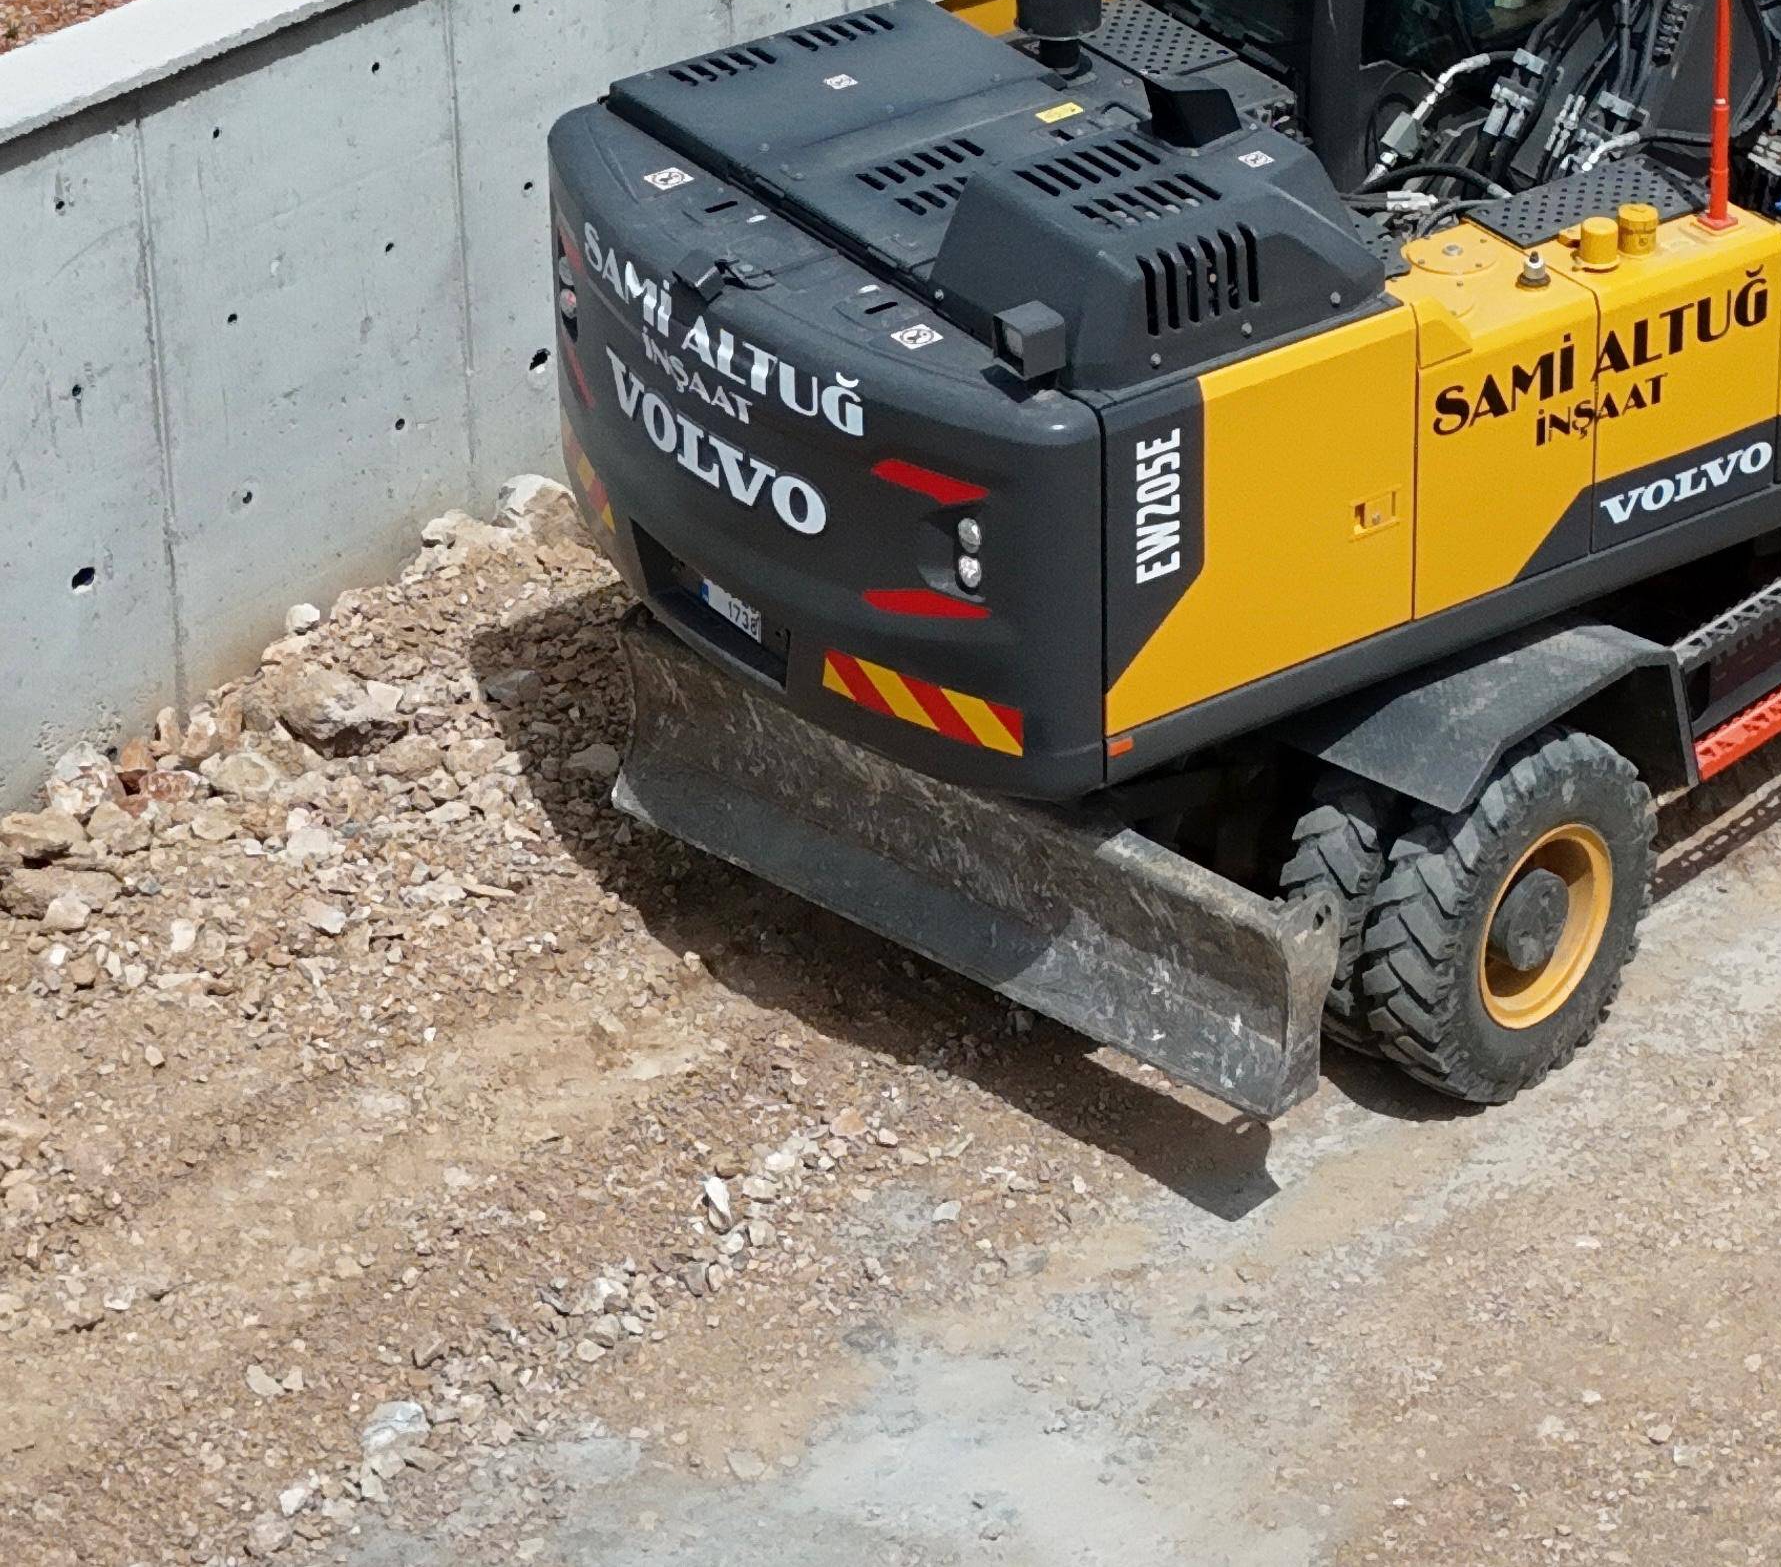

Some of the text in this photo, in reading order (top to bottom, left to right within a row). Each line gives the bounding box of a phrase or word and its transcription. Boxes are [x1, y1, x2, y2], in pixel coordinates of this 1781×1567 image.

[584, 221, 864, 437] SAMİ ALTUĞ
[641, 326, 753, 425] İNŞAAT
[1432, 265, 1769, 436] SAMİ ALTUĞ
[605, 345, 827, 535] VOLVO
[1535, 372, 1669, 447] İNŞAAT
[1600, 440, 1773, 525] VOLVO
[1135, 428, 1182, 584] EW205E
